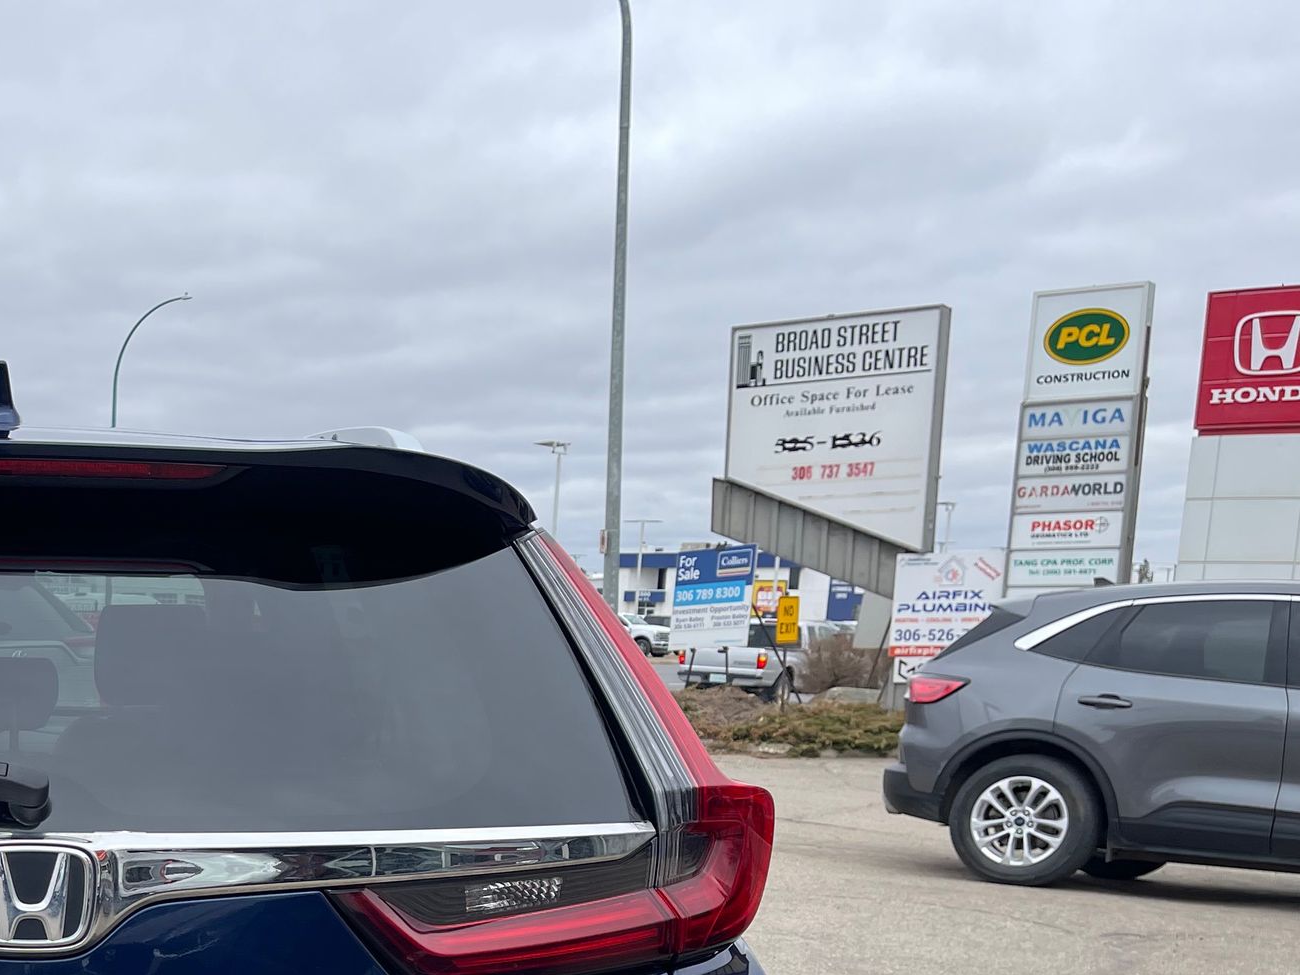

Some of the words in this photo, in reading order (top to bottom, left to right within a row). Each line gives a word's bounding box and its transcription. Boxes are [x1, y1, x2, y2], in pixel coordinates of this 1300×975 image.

[775, 327, 832, 353] BROAD
[836, 320, 902, 348] STREET
[1056, 323, 1116, 350] PCL
[773, 352, 856, 380] BUSINESS
[861, 345, 929, 372] CENTRE
[1036, 369, 1130, 385] CONSTRUCTION
[750, 393, 795, 407] Office
[801, 391, 839, 405] Space
[846, 387, 869, 400] For
[875, 384, 914, 397] Lease
[1209, 385, 1300, 405] HOND
[1027, 438, 1121, 454] WASCANA
[1025, 453, 1071, 466] DRIVING
[1075, 451, 1120, 463] SCHOOL
[820, 464, 840, 479] 737
[846, 461, 876, 477] 3547
[1030, 519, 1095, 532] PHASOR
[679, 555, 698, 567] For
[721, 556, 748, 566] Colliers
[1040, 558, 1058, 566] CPA
[678, 569, 700, 581] Sale
[675, 590, 694, 602] 306
[695, 588, 713, 600] 789
[715, 586, 741, 599] 8300
[916, 589, 984, 600] AIRFIX
[709, 604, 750, 614] Opportunity
[783, 605, 795, 617] NO
[780, 622, 796, 634] EXIT
